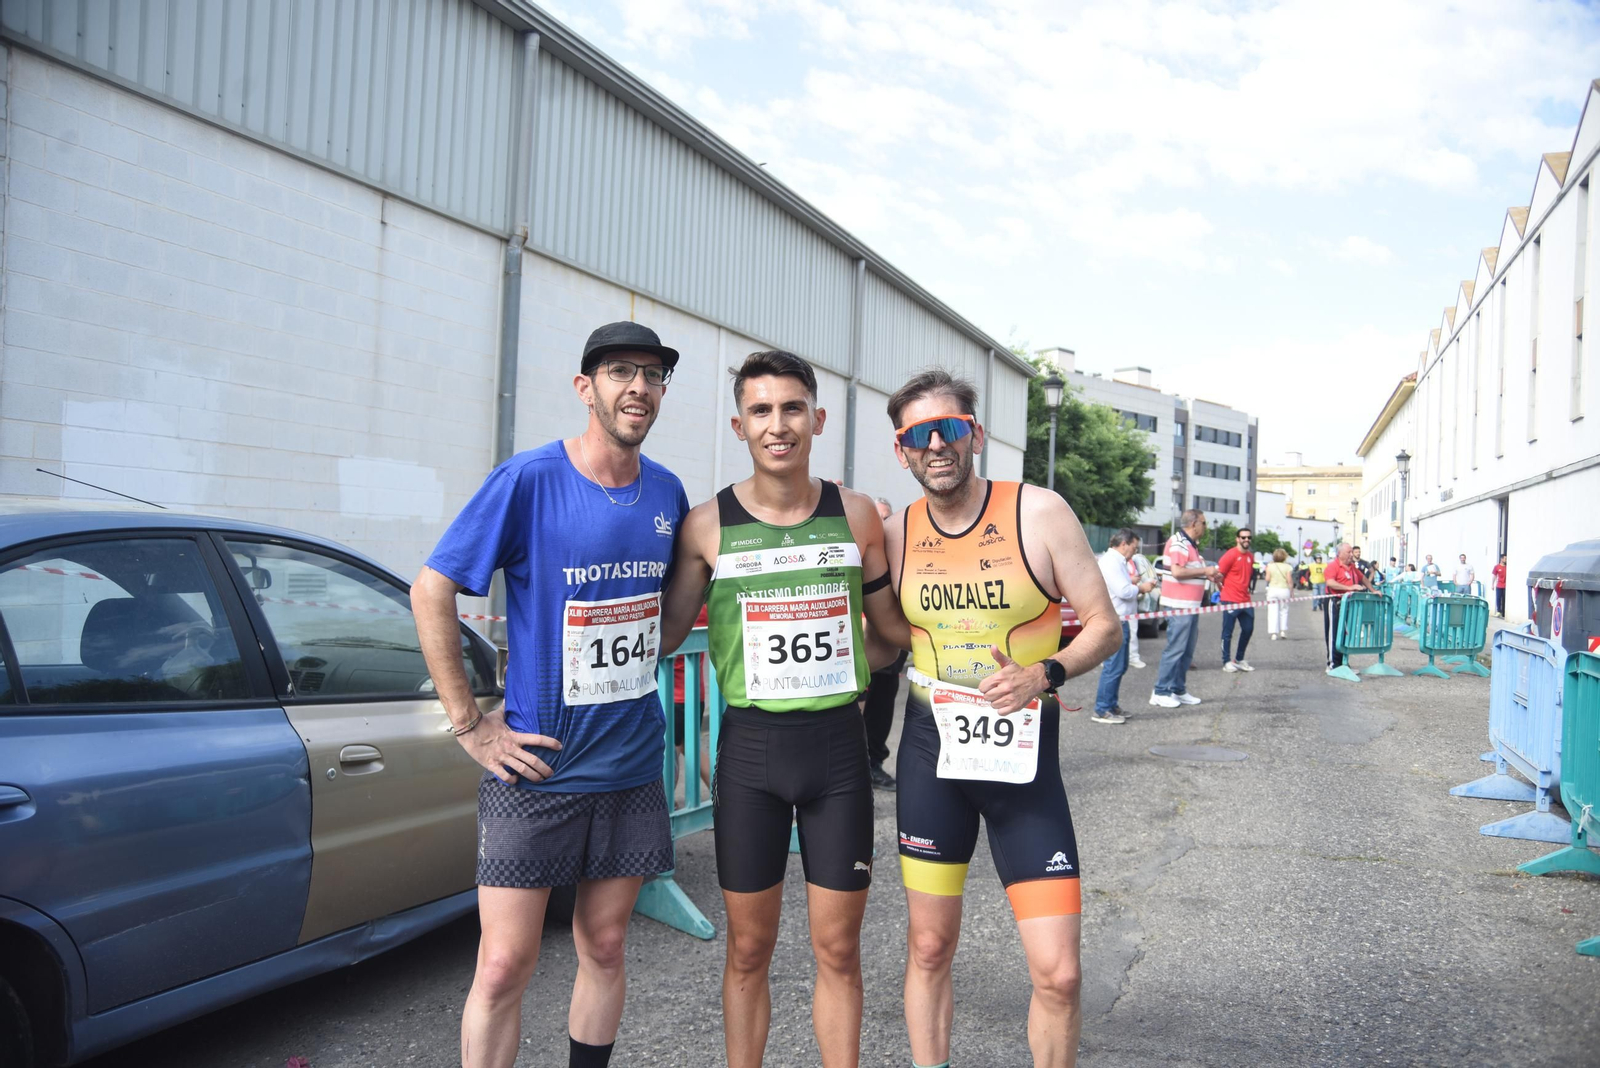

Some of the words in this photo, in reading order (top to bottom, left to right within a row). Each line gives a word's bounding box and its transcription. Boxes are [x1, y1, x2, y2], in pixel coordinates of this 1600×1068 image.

[920, 580, 1010, 610] GONZALEZ
[583, 608, 612, 617] CARRERA
[614, 604, 630, 614] MARÍA
[760, 604, 788, 613] CARRERA
[790, 602, 810, 611] MARÍA
[769, 612, 795, 620] MEMORIAL
[590, 632, 646, 668] 164
[768, 631, 832, 664] 365
[955, 715, 1014, 747] 349
[910, 836, 934, 846] ENERGY
